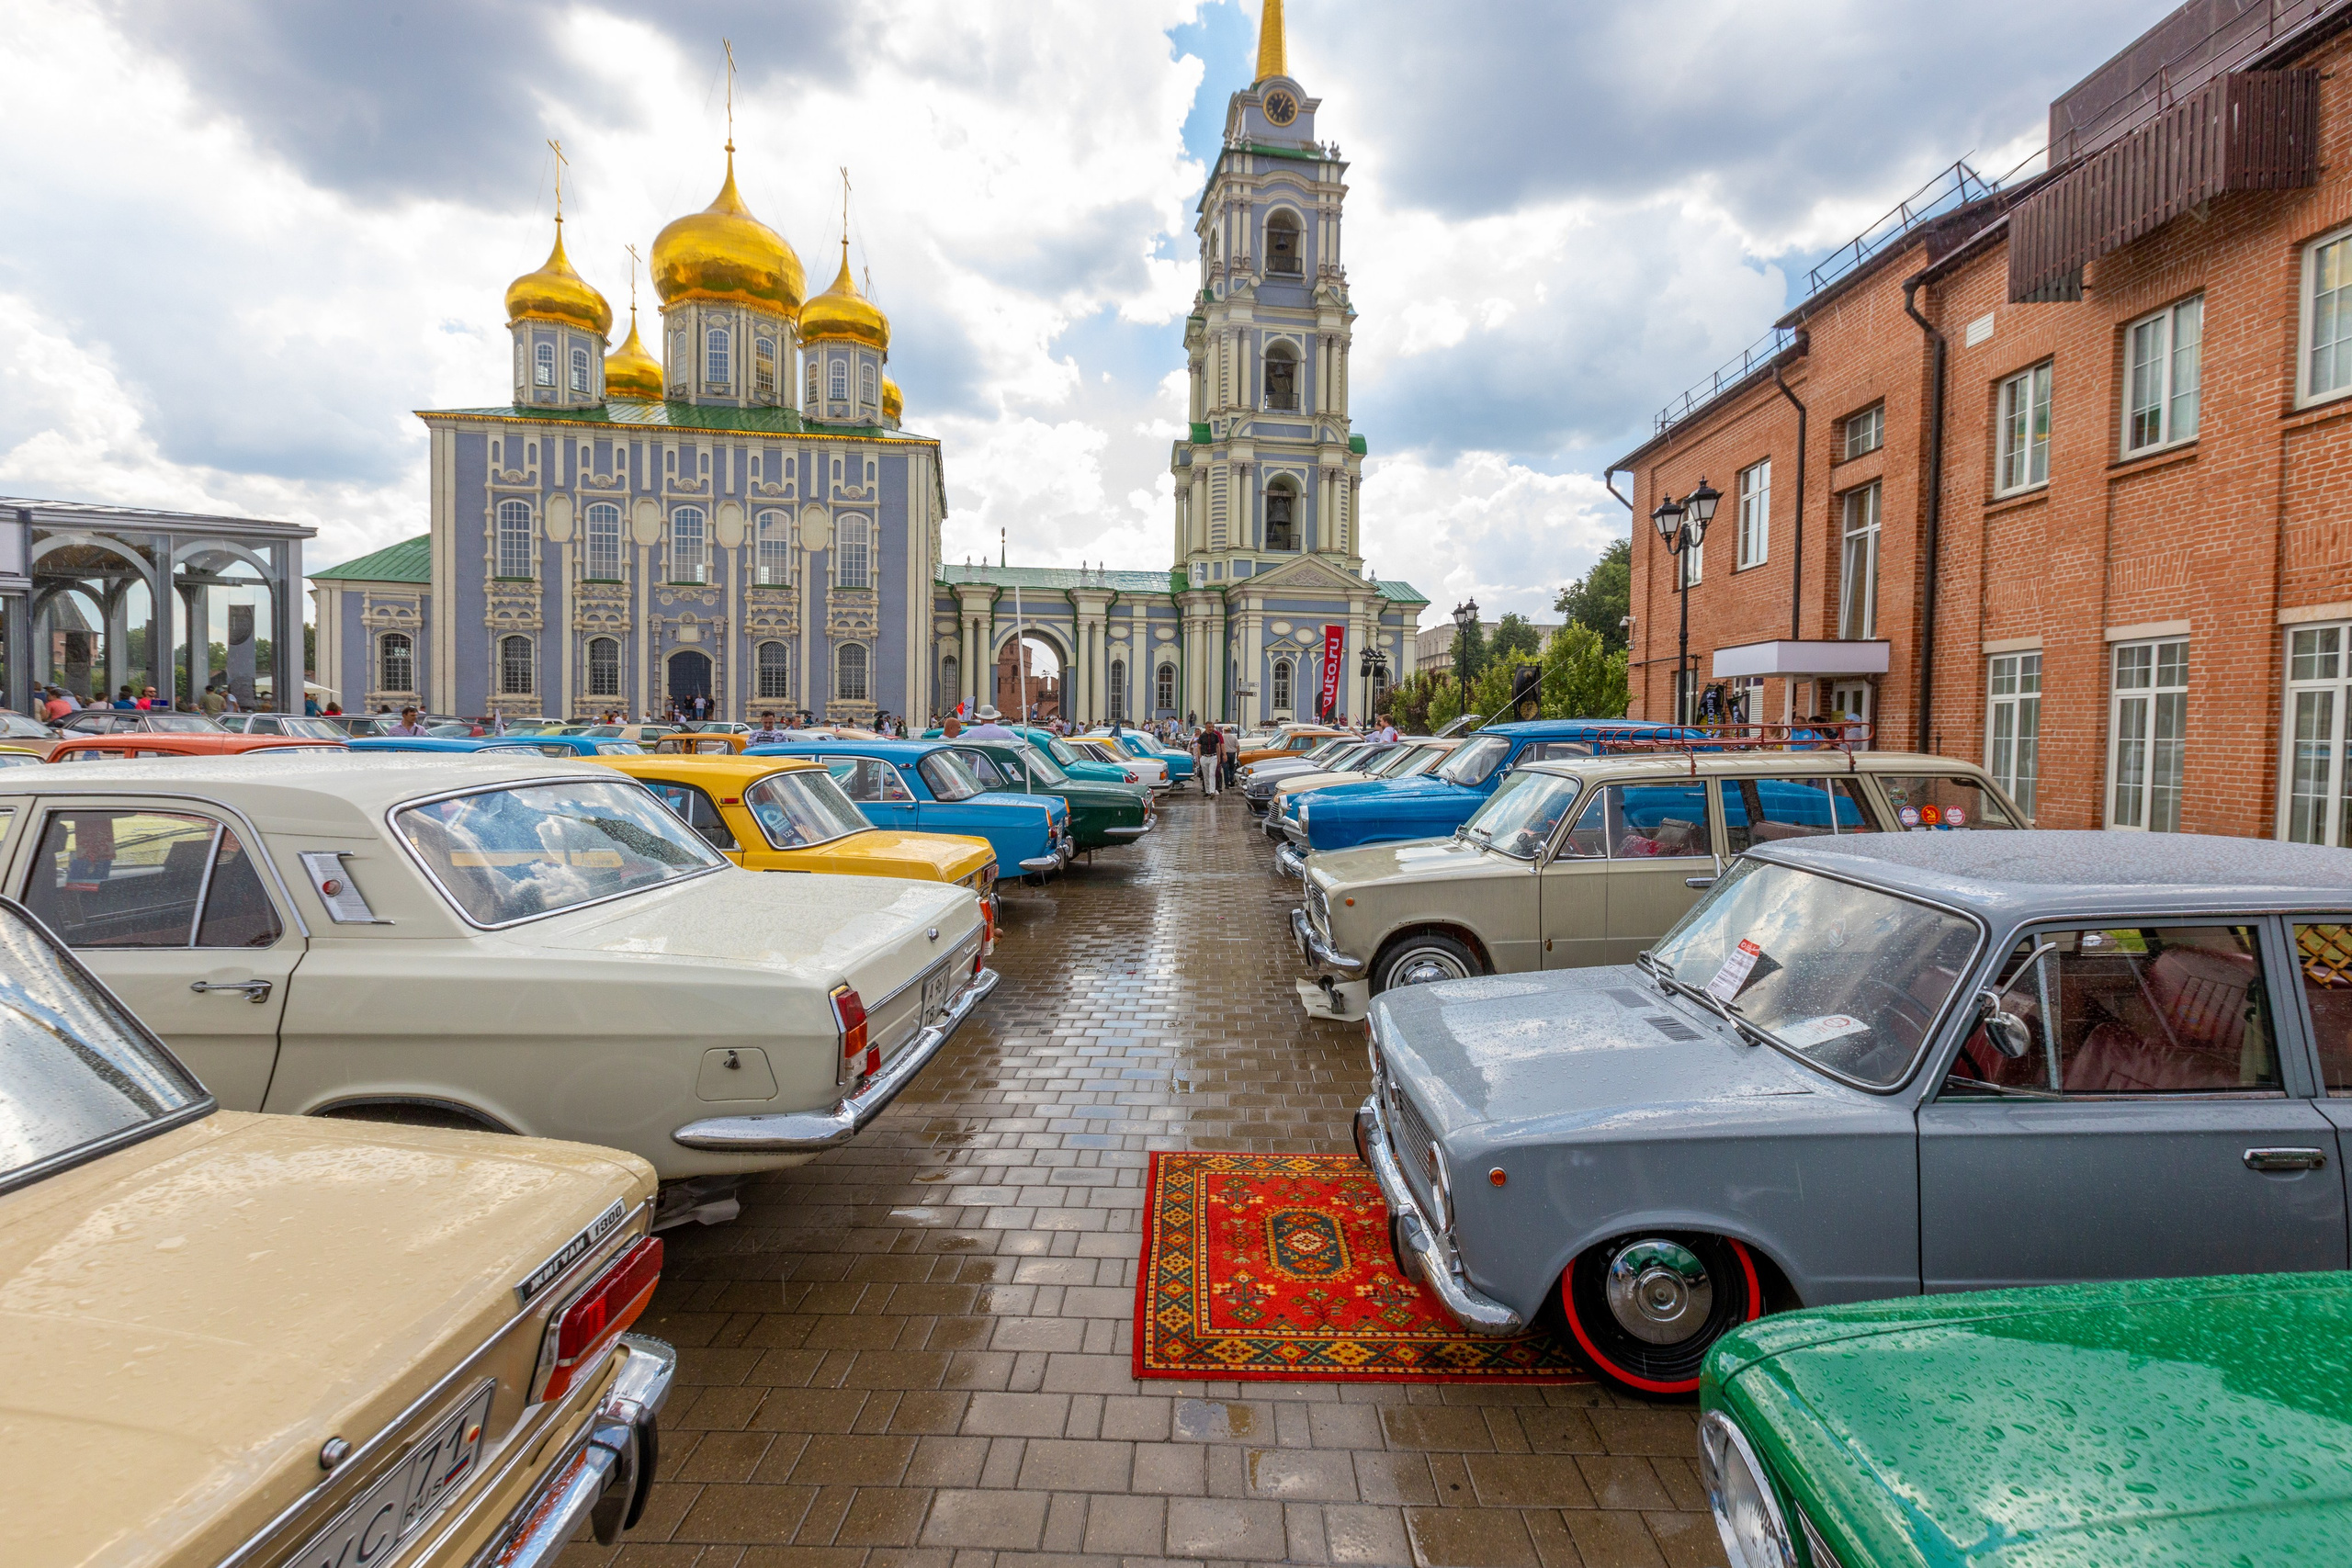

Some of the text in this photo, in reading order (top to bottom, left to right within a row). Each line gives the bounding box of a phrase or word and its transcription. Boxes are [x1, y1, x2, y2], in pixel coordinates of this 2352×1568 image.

[1323, 637, 1340, 708] auto.ru
[530, 1204, 623, 1293] ЖИГУЛИ 1300
[416, 1412, 469, 1499] 71
[402, 1477, 443, 1526] RUS
